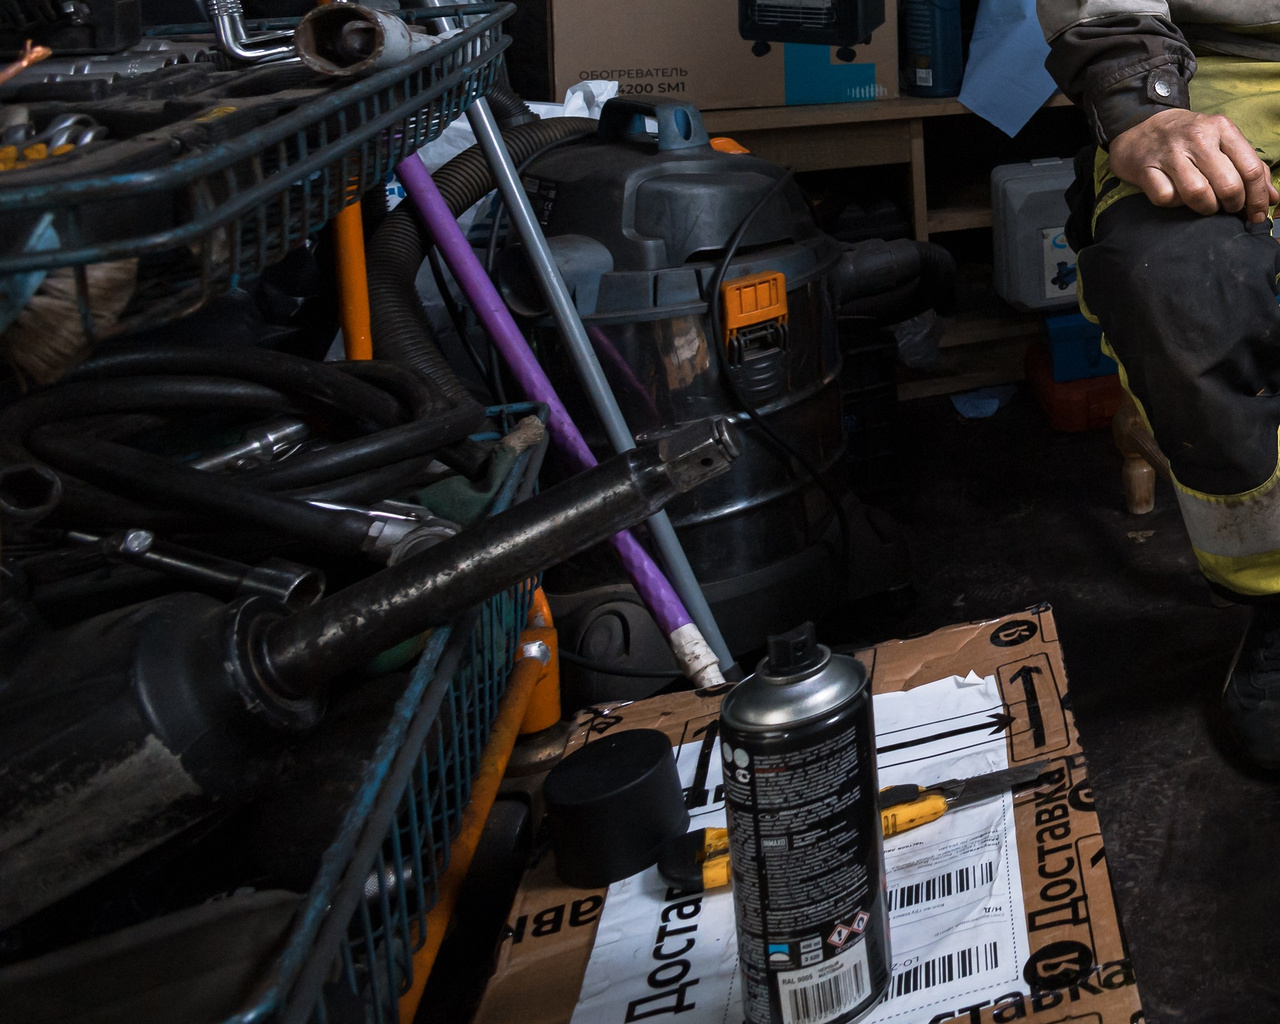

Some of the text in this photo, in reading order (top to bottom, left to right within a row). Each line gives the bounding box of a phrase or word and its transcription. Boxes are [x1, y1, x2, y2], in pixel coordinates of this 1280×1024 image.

[579, 67, 688, 81] ОБОГРЕВАТЕЛЬ
[657, 82, 686, 93] SM1
[1028, 766, 1090, 933] Доставка
[782, 977, 796, 986] RAL
